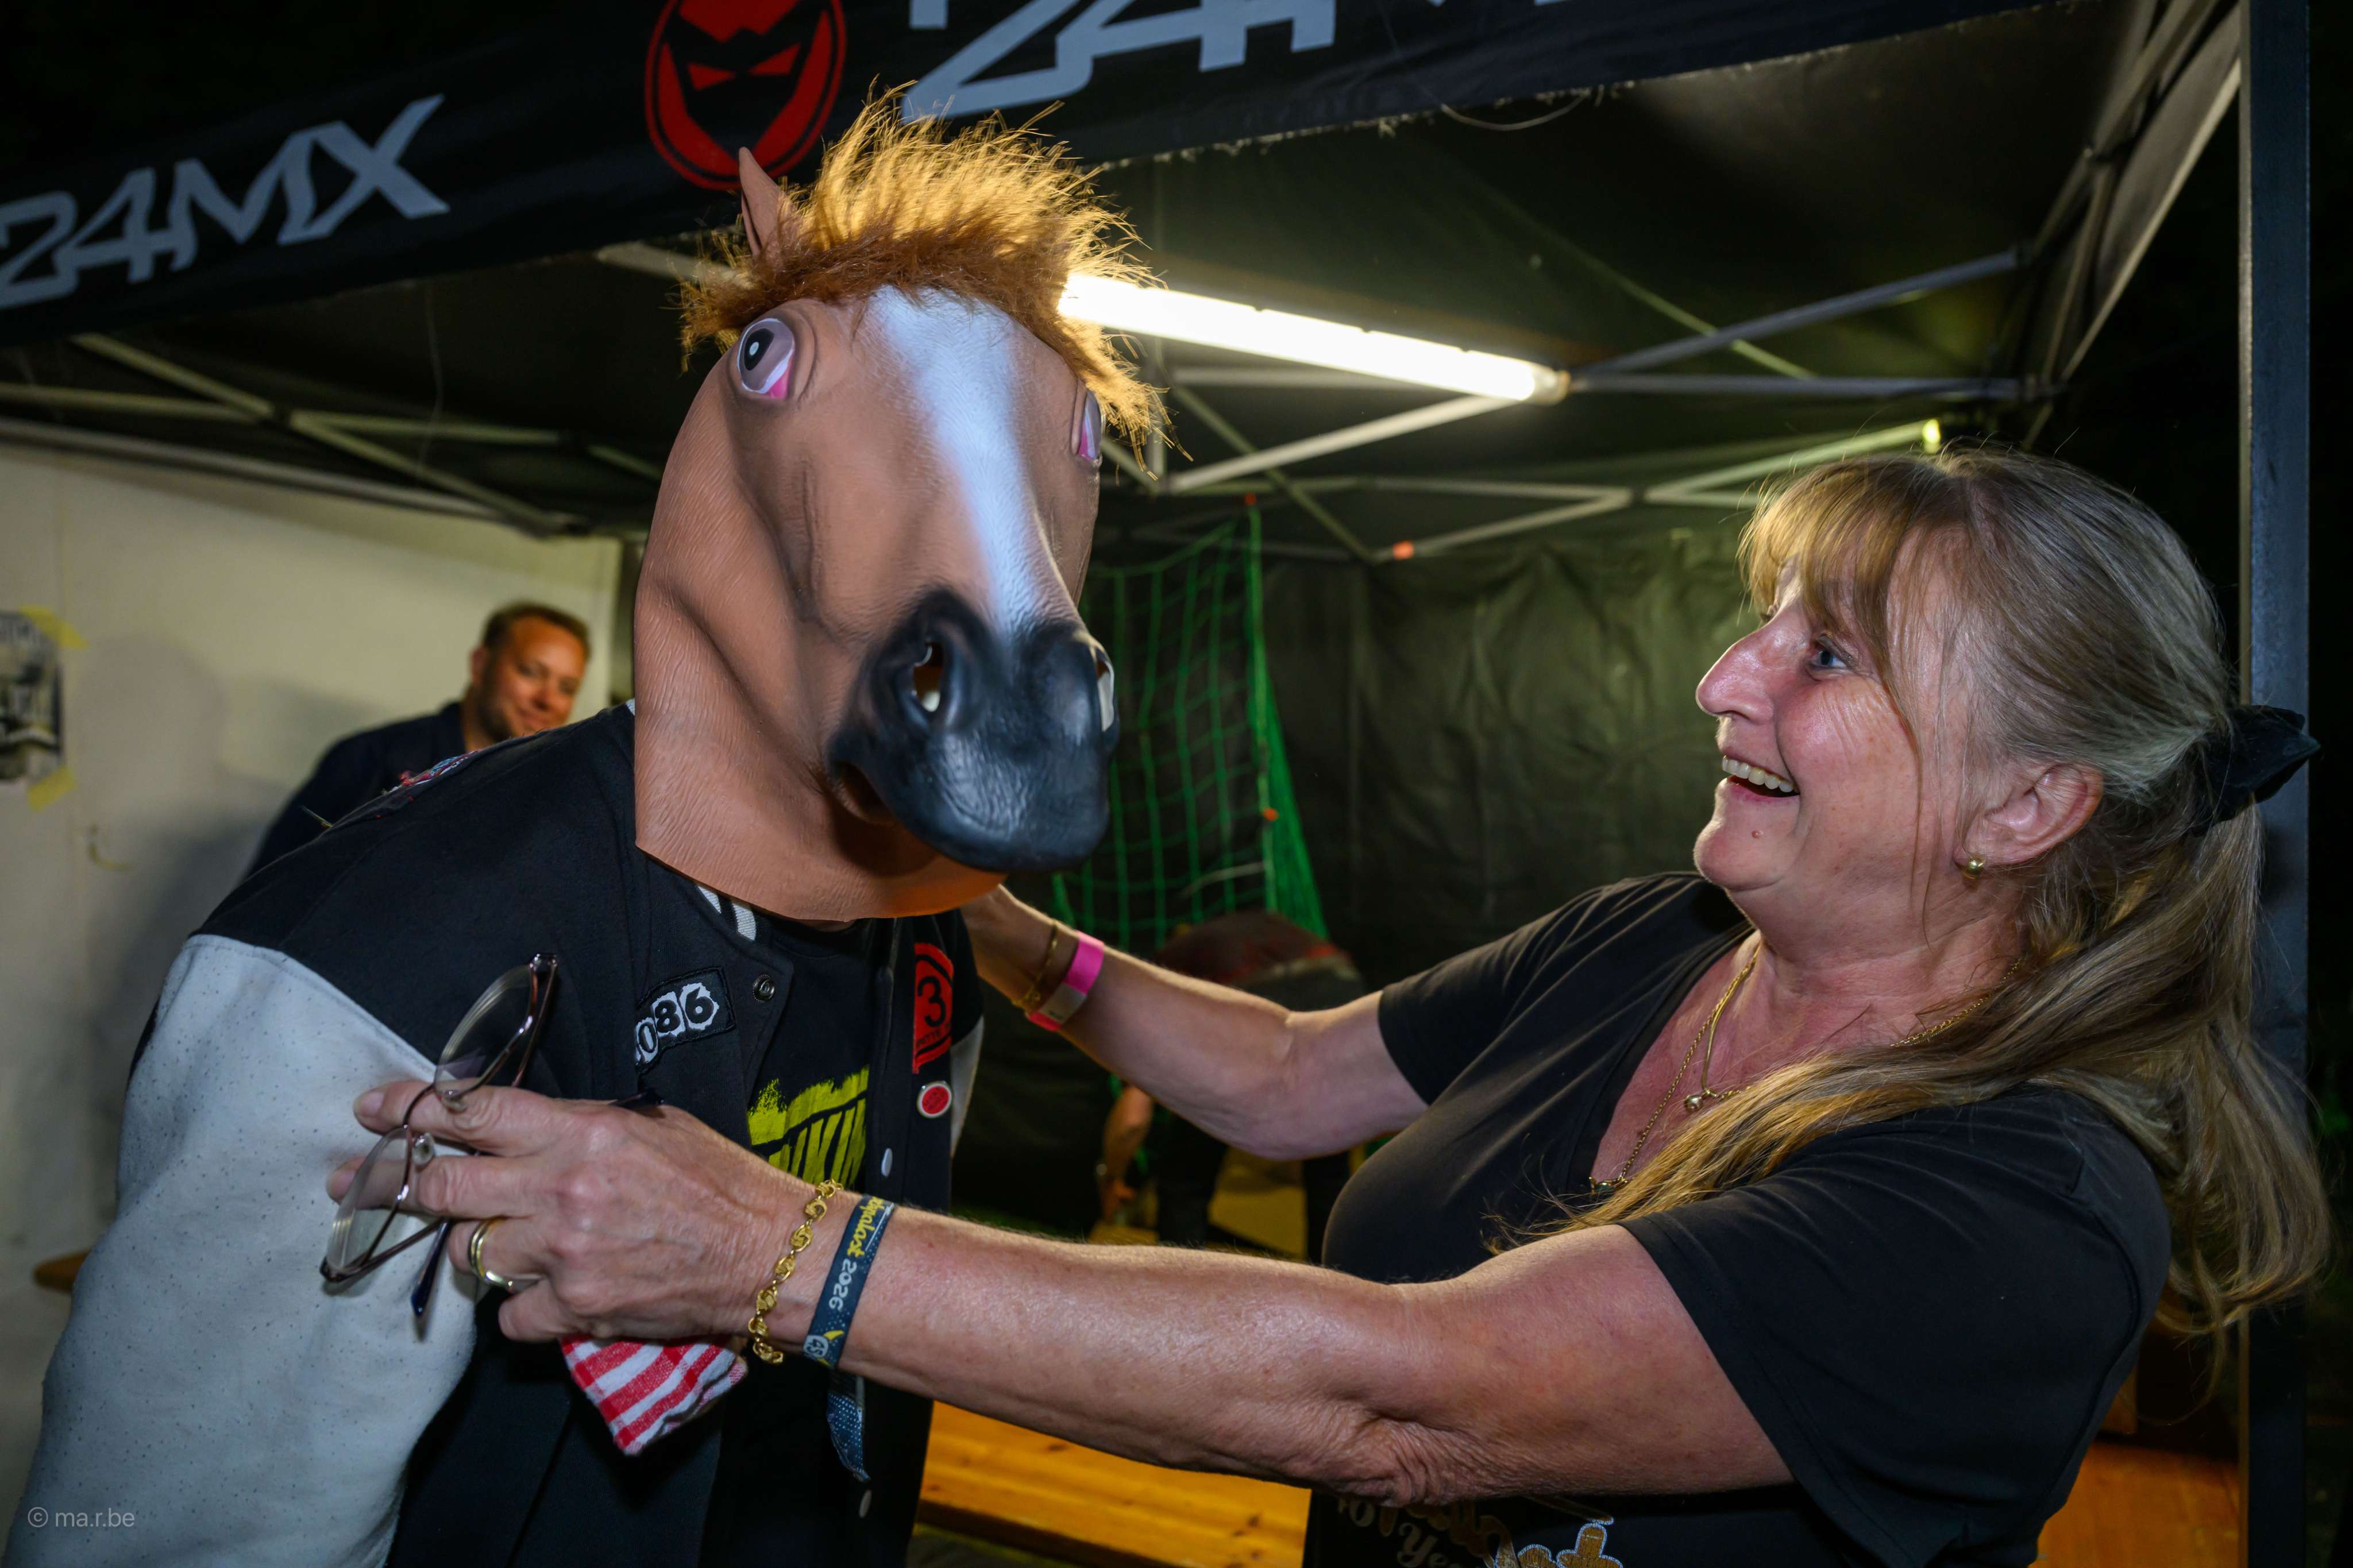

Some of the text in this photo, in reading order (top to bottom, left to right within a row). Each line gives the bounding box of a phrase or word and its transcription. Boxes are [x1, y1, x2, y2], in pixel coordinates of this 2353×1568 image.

[0, 94, 450, 311] 24MX
[636, 984, 717, 1058] 086
[917, 976, 945, 1027] 3
[829, 1258, 857, 1310] 2026
